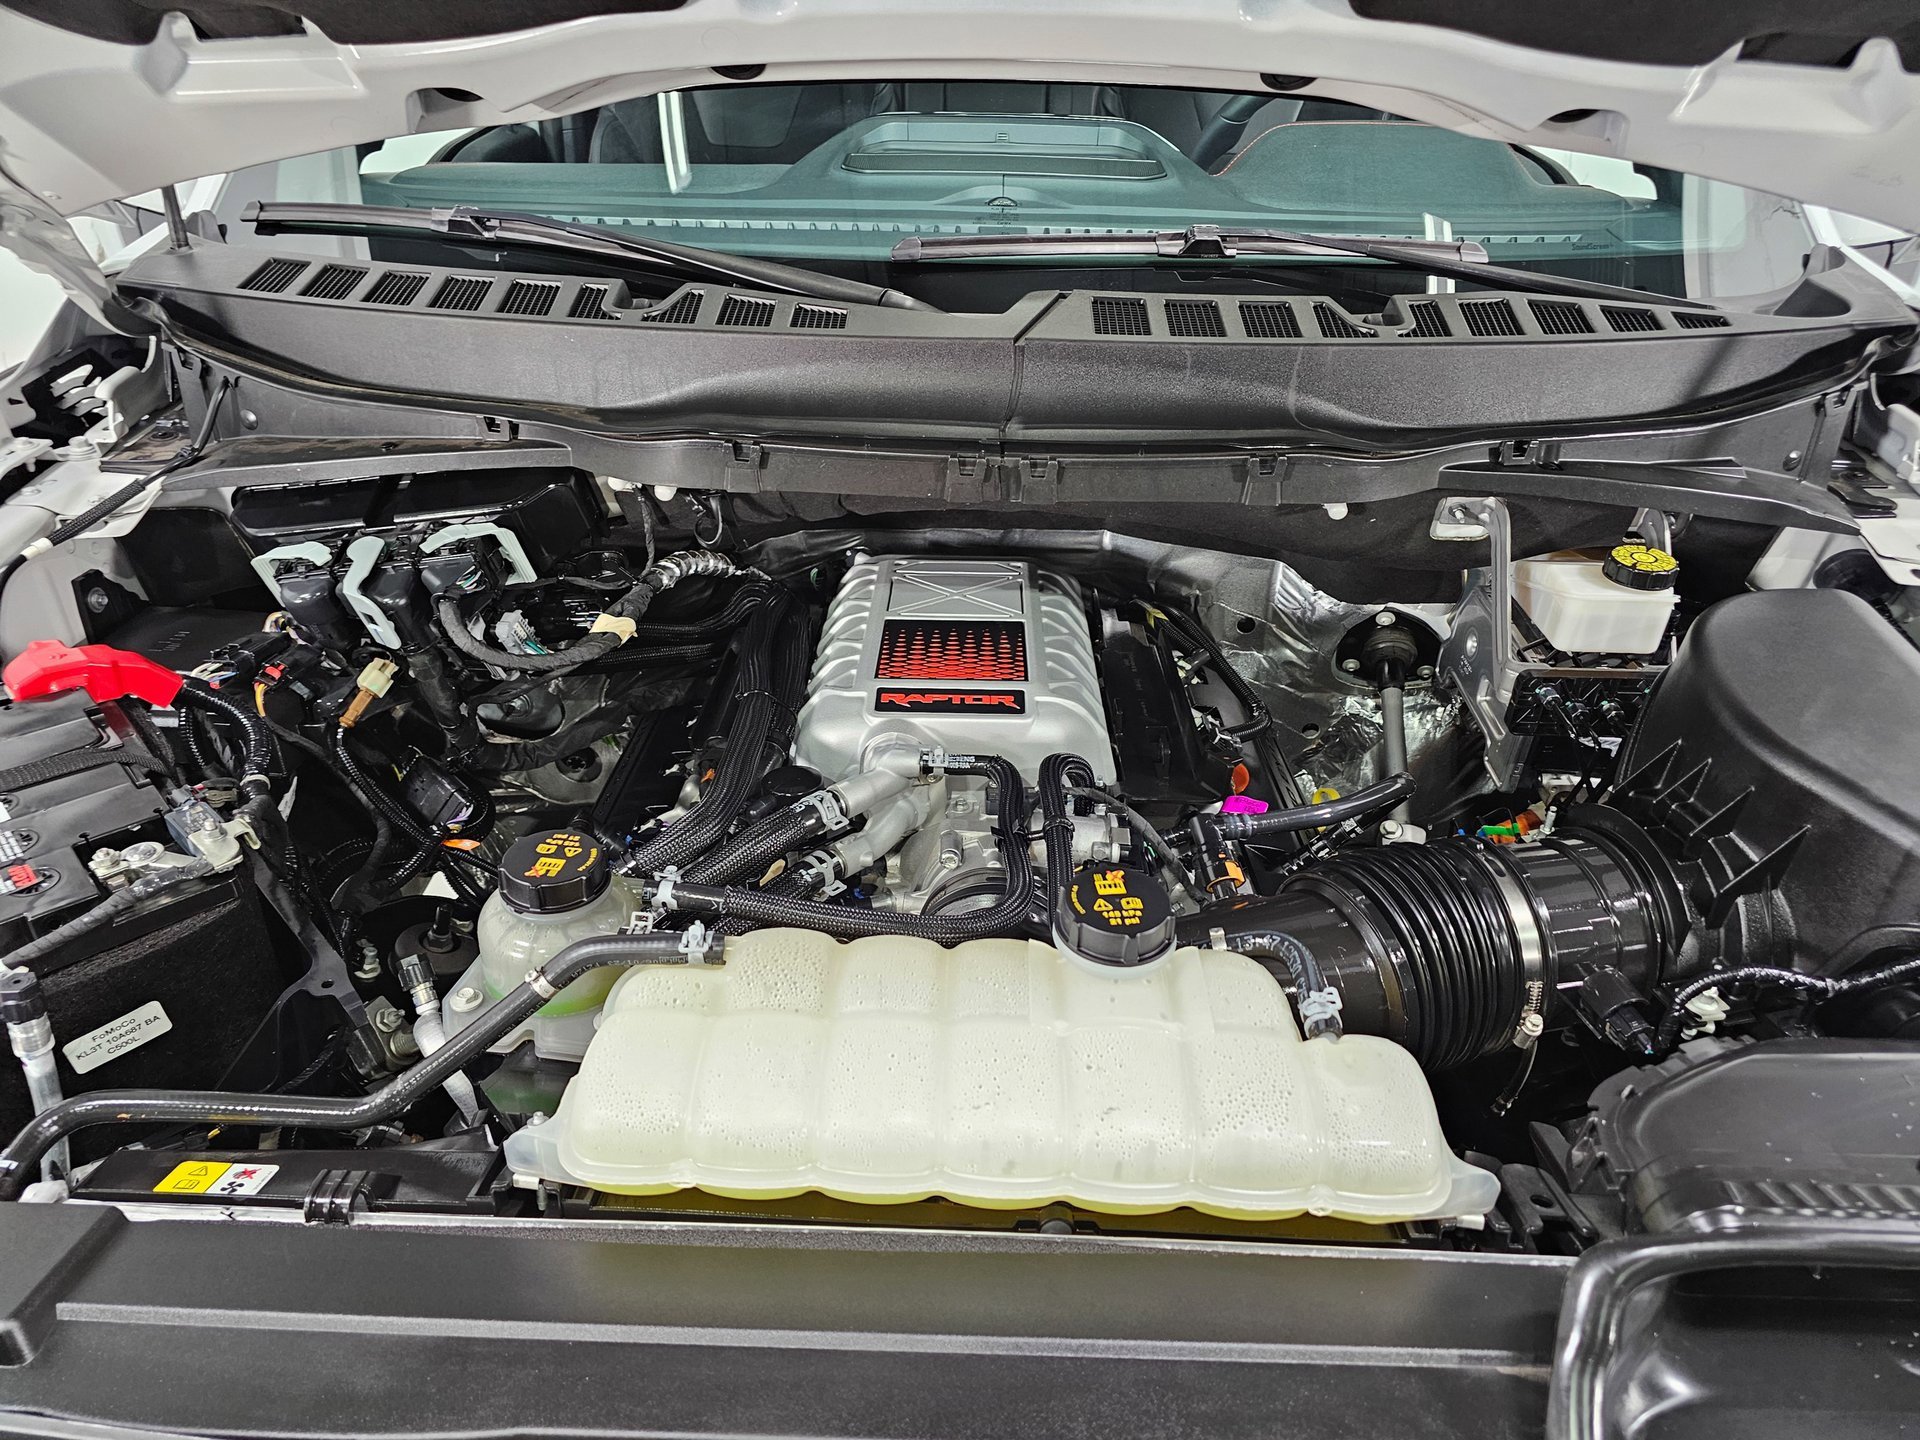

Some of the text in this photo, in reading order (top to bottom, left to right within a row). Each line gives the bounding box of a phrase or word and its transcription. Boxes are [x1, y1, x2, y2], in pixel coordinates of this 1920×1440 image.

[880, 693, 1020, 709] RAPTOR
[75, 1042, 103, 1060] KL3T
[144, 1015, 161, 1026] BA
[91, 1018, 136, 1042] FoMoCo
